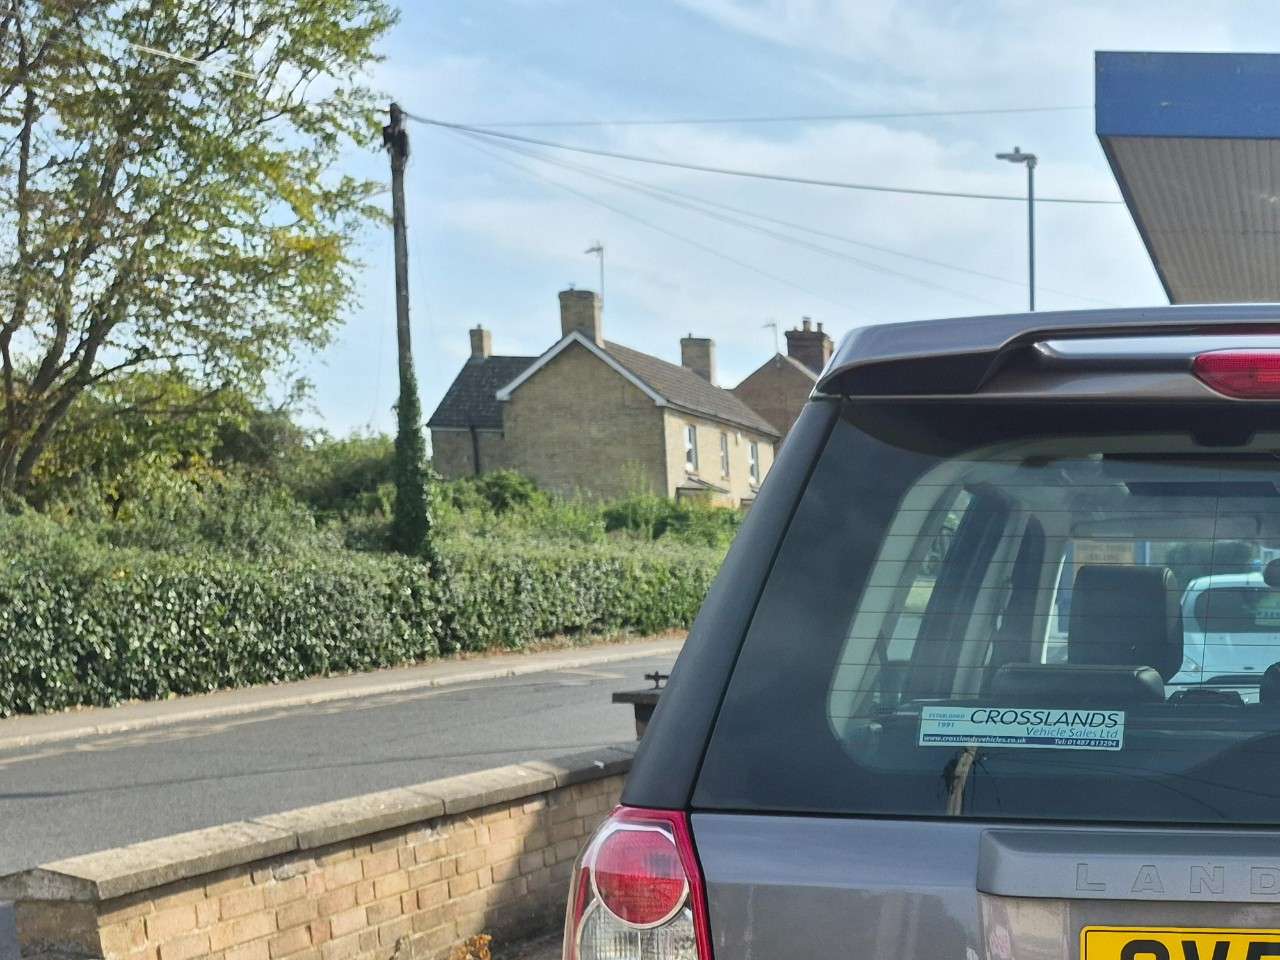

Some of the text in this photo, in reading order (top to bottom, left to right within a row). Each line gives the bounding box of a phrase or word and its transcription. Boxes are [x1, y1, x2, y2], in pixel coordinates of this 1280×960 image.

[970, 709, 1119, 728] CROSSLANDS
[1026, 726, 1119, 739] Vehicle Sales Ltd
